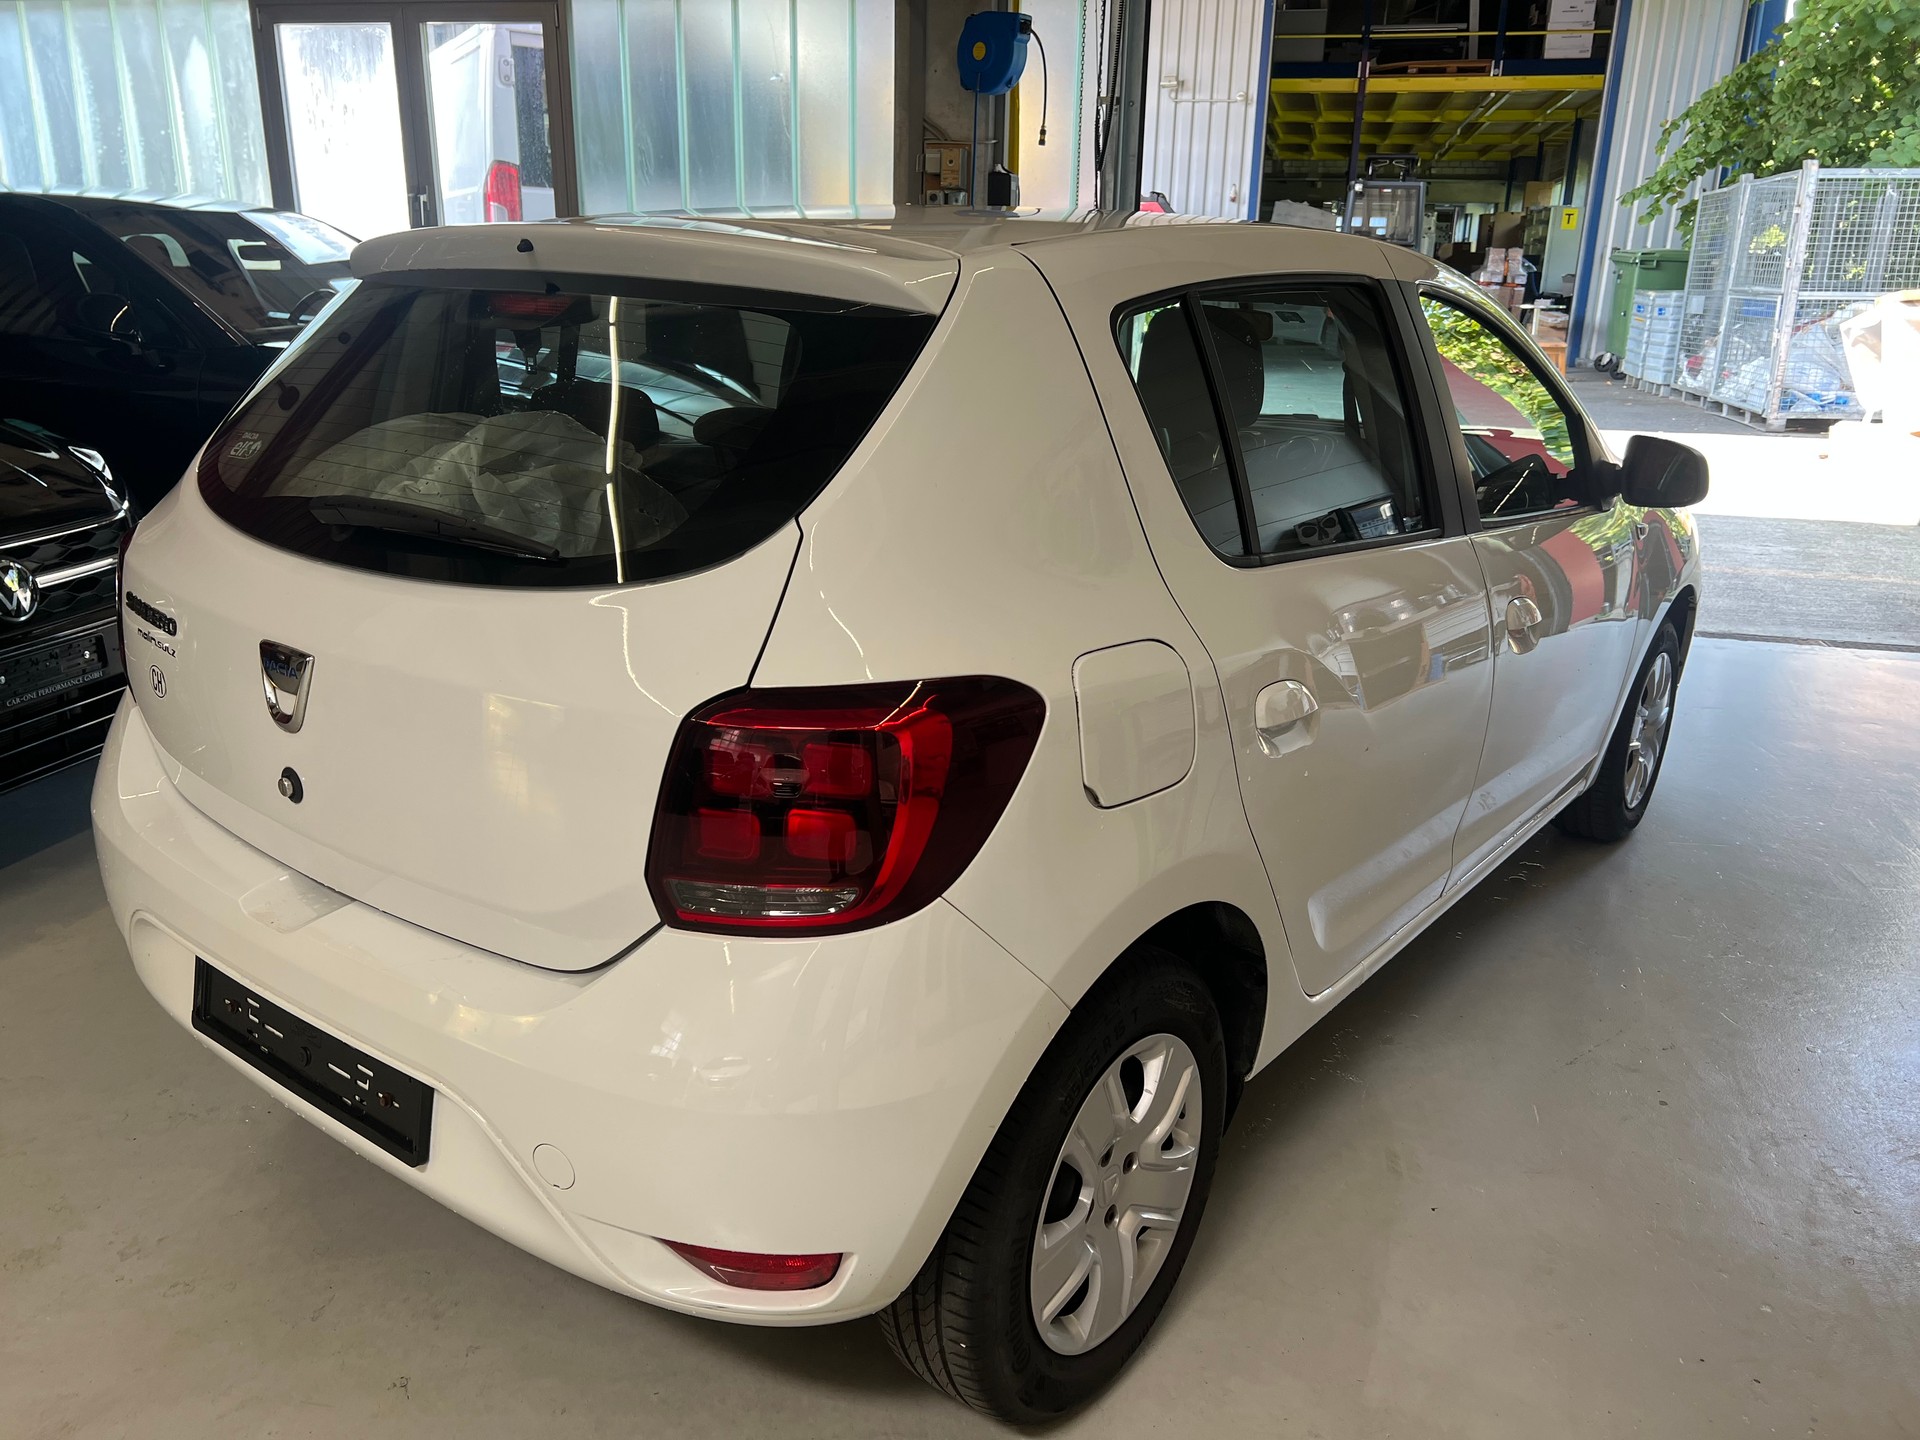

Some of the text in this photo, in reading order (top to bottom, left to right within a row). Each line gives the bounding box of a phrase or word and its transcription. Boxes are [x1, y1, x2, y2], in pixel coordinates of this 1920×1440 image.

[1564, 213, 1575, 225] T
[6, 669, 104, 707] CAR-ONE PERFORMANCE GMBH
[151, 667, 164, 696] CH
